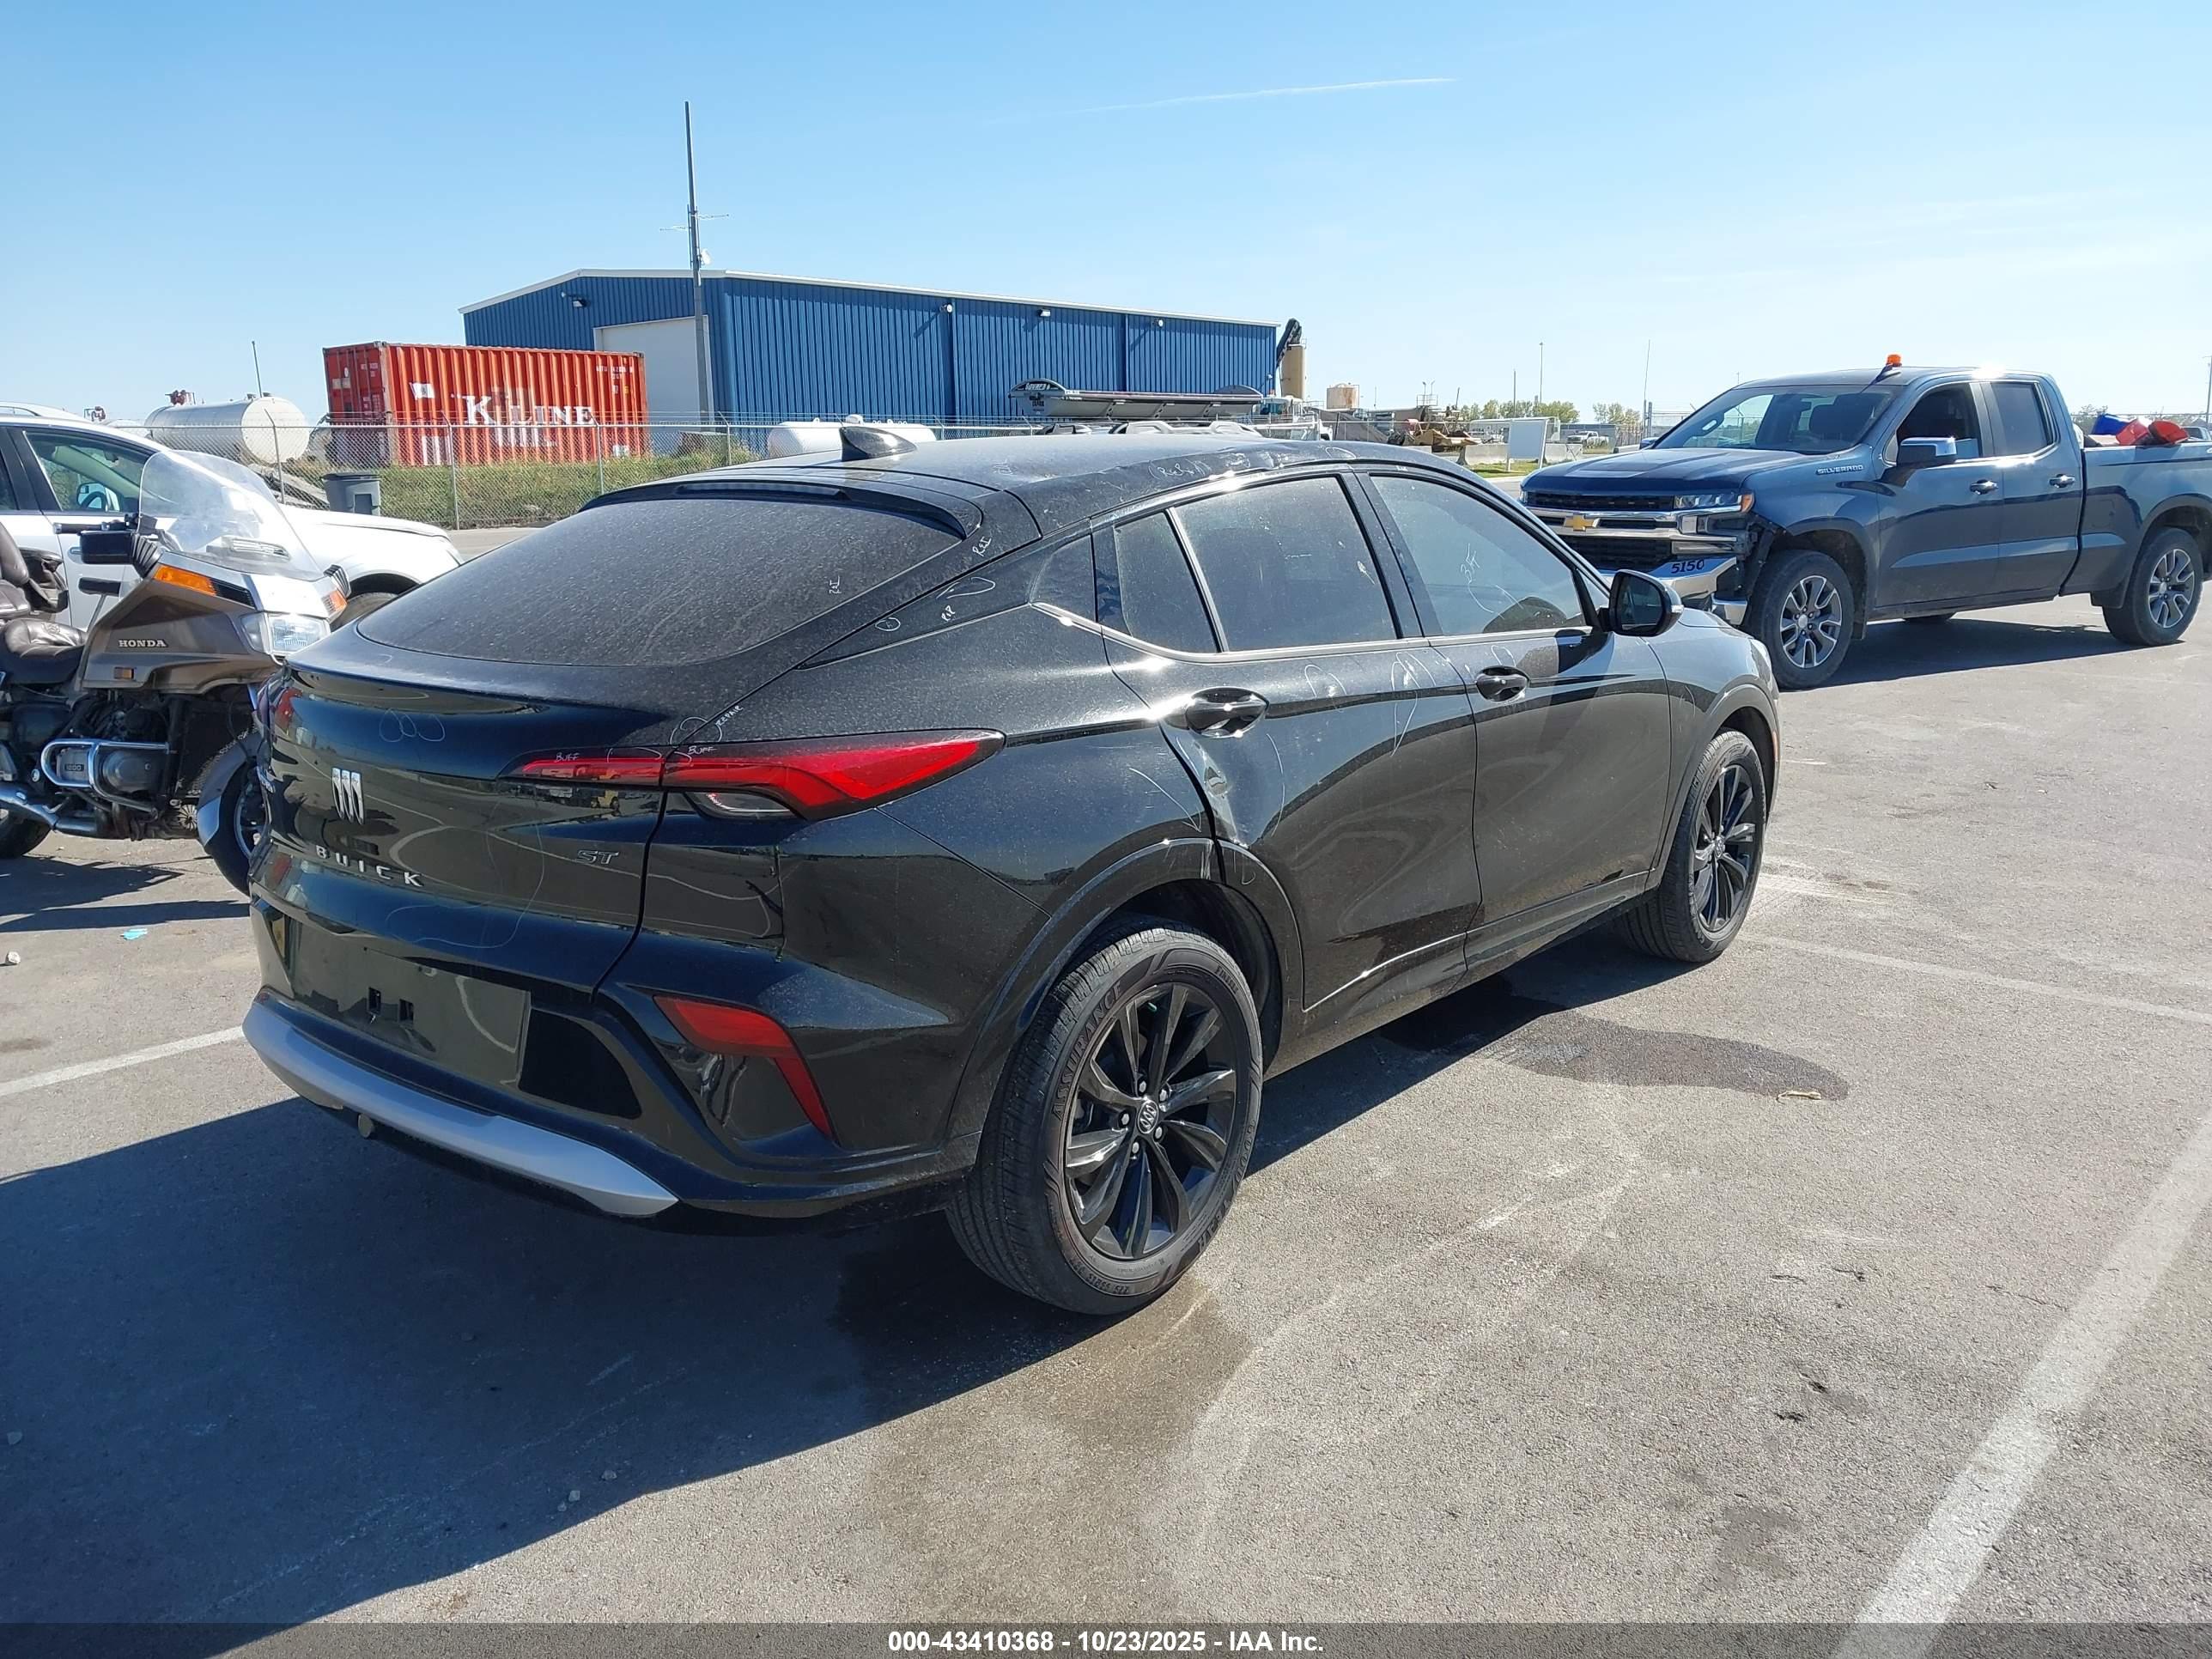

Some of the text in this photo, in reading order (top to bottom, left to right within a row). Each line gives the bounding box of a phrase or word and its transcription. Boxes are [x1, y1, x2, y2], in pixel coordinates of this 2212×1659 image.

[510, 404, 594, 425] LINE
[1816, 465, 1863, 475] SILVERADO
[1671, 559, 1705, 574] 5150
[554, 752, 580, 763] BUFF
[688, 745, 717, 756] BUFF
[577, 850, 619, 865] ST
[316, 845, 423, 888] BUICK
[1051, 981, 1121, 1121] ASSURANCE
